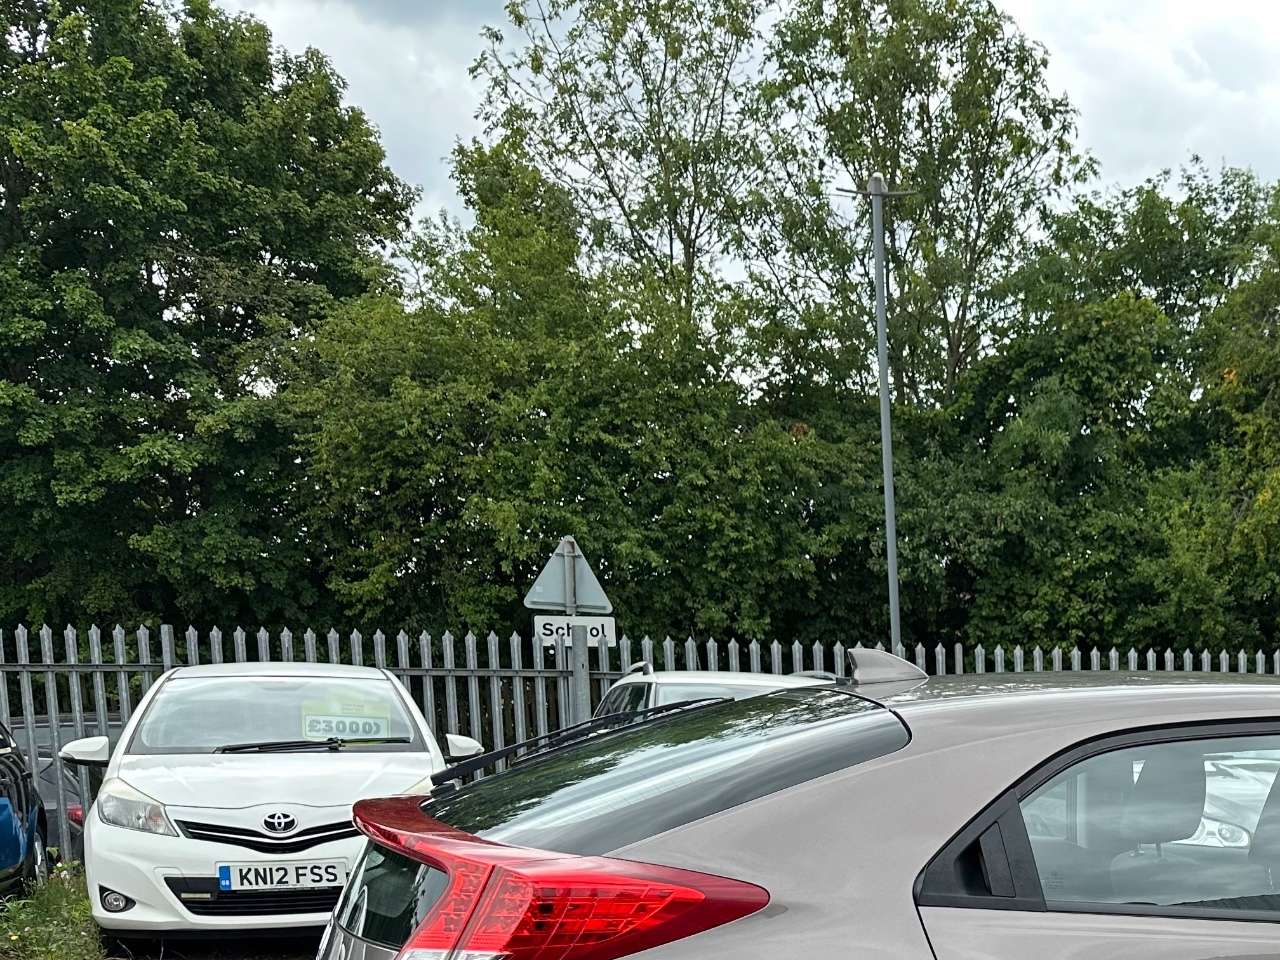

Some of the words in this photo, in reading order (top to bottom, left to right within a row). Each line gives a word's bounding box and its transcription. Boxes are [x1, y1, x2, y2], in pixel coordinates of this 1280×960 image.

[542, 622, 607, 638] Schol
[239, 866, 289, 886] KN12
[295, 864, 338, 884] FSS
